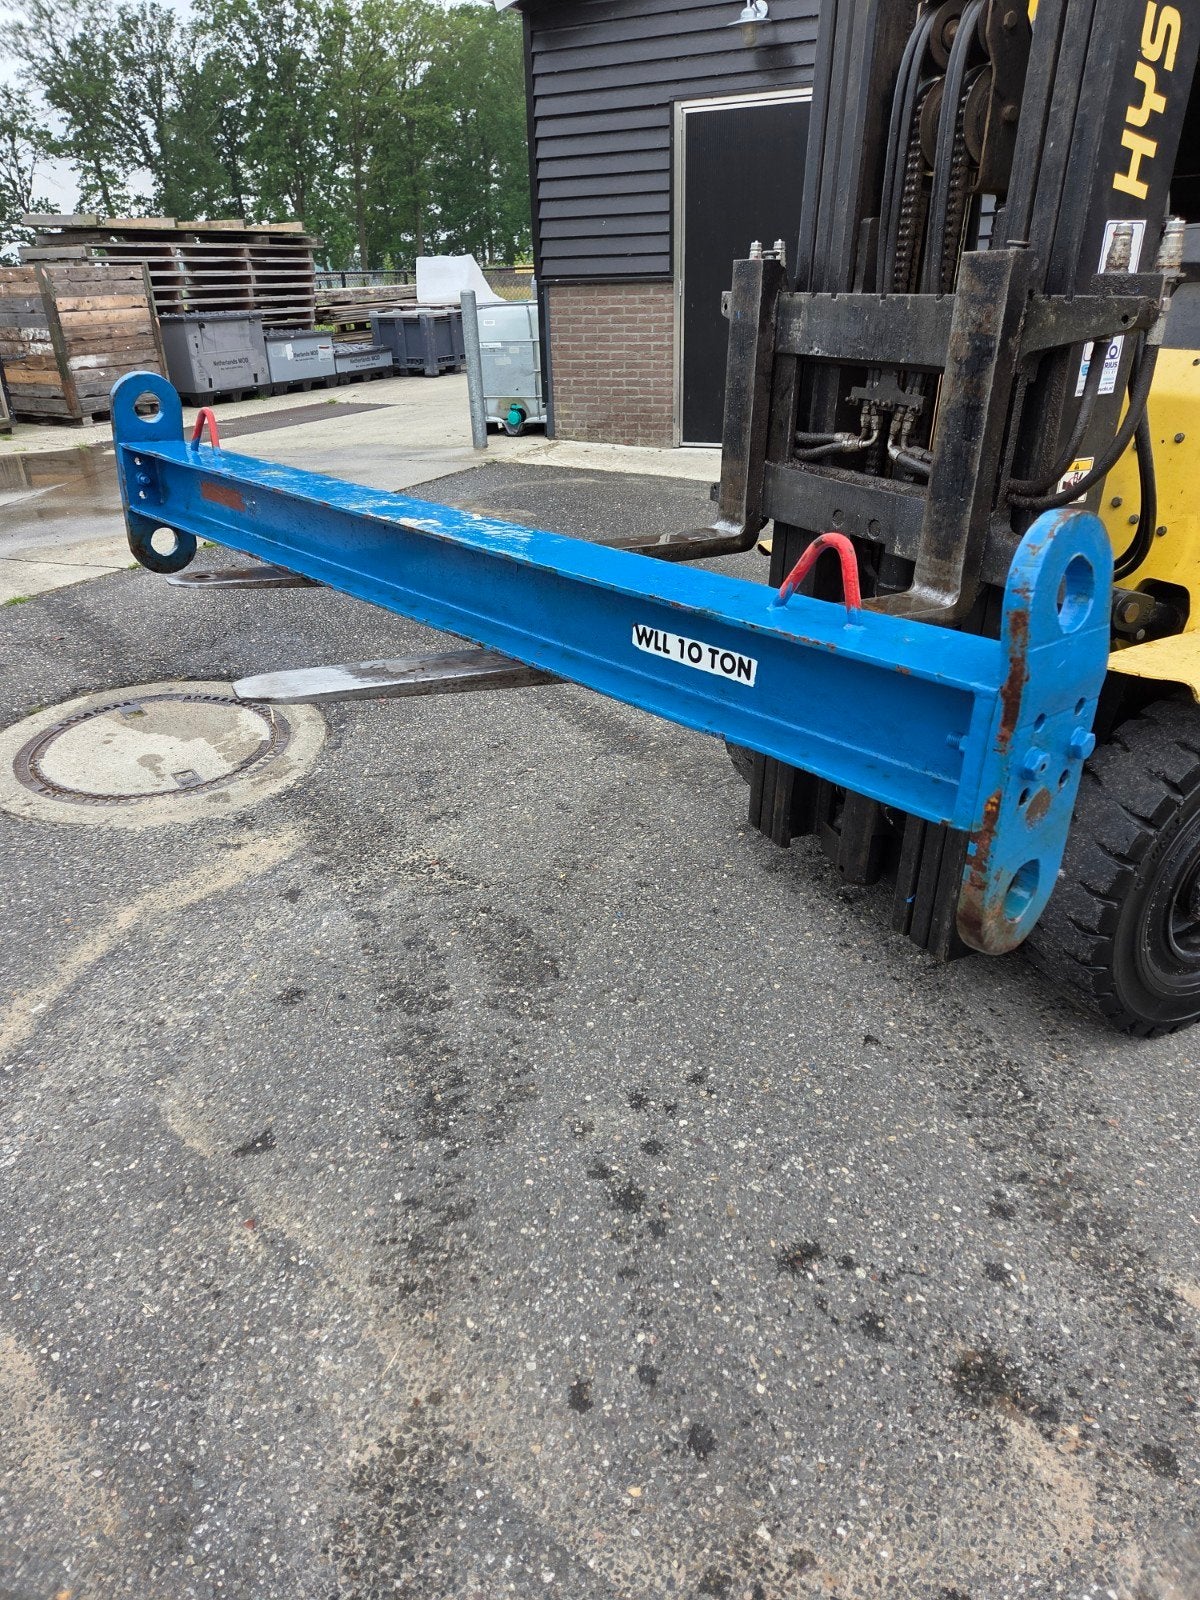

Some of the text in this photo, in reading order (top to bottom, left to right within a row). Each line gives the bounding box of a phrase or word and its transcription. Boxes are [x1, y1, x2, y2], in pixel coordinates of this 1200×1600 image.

[213, 359, 238, 367] Netherlands
[633, 622, 752, 681] WLL 10 TON
